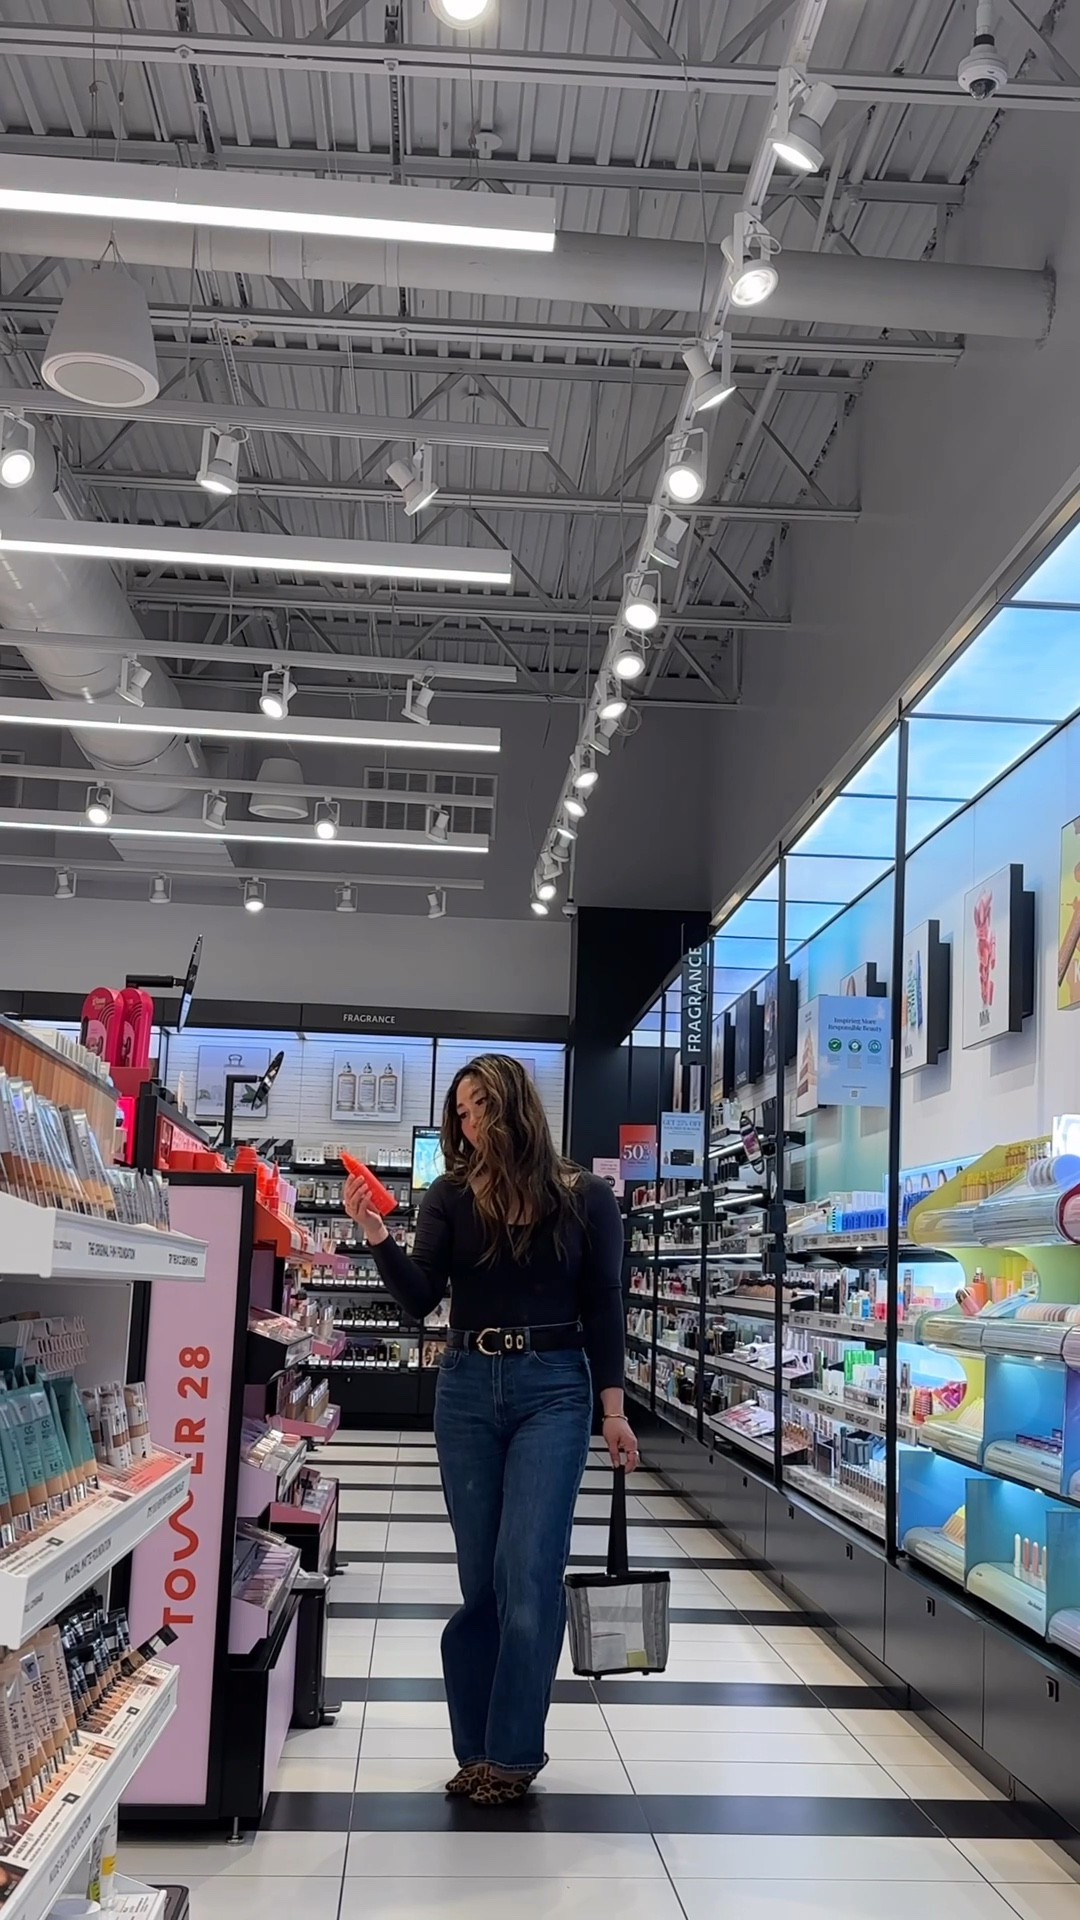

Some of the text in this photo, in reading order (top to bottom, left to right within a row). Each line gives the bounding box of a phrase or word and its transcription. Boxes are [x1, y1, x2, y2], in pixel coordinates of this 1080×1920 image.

[688, 947, 702, 1052] FRAGRANCE
[343, 1013, 396, 1024] FRAGRANCE
[862, 1025, 882, 1033] Beauty
[177, 1346, 210, 1399] 28
